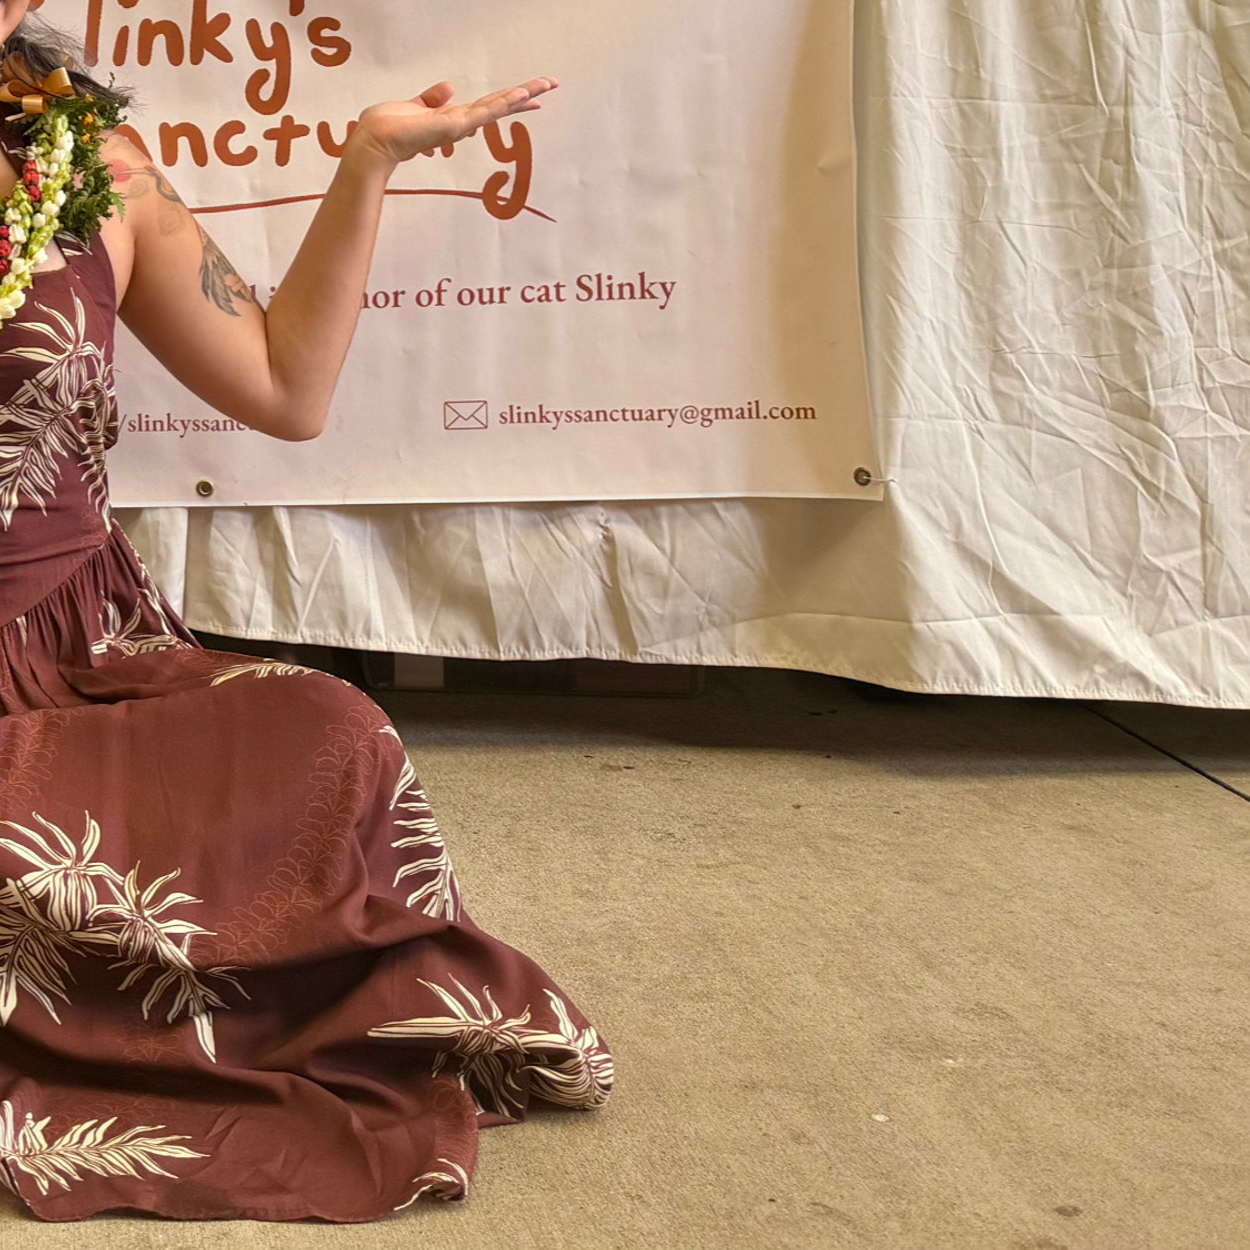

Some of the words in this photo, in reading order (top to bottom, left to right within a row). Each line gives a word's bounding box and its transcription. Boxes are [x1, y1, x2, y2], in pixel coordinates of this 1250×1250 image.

[415, 278, 452, 307] of
[456, 284, 512, 306] our
[520, 282, 565, 304] cat
[575, 271, 677, 310] Slinky
[498, 400, 818, 430] slinkyssanctuary@gmail.com
